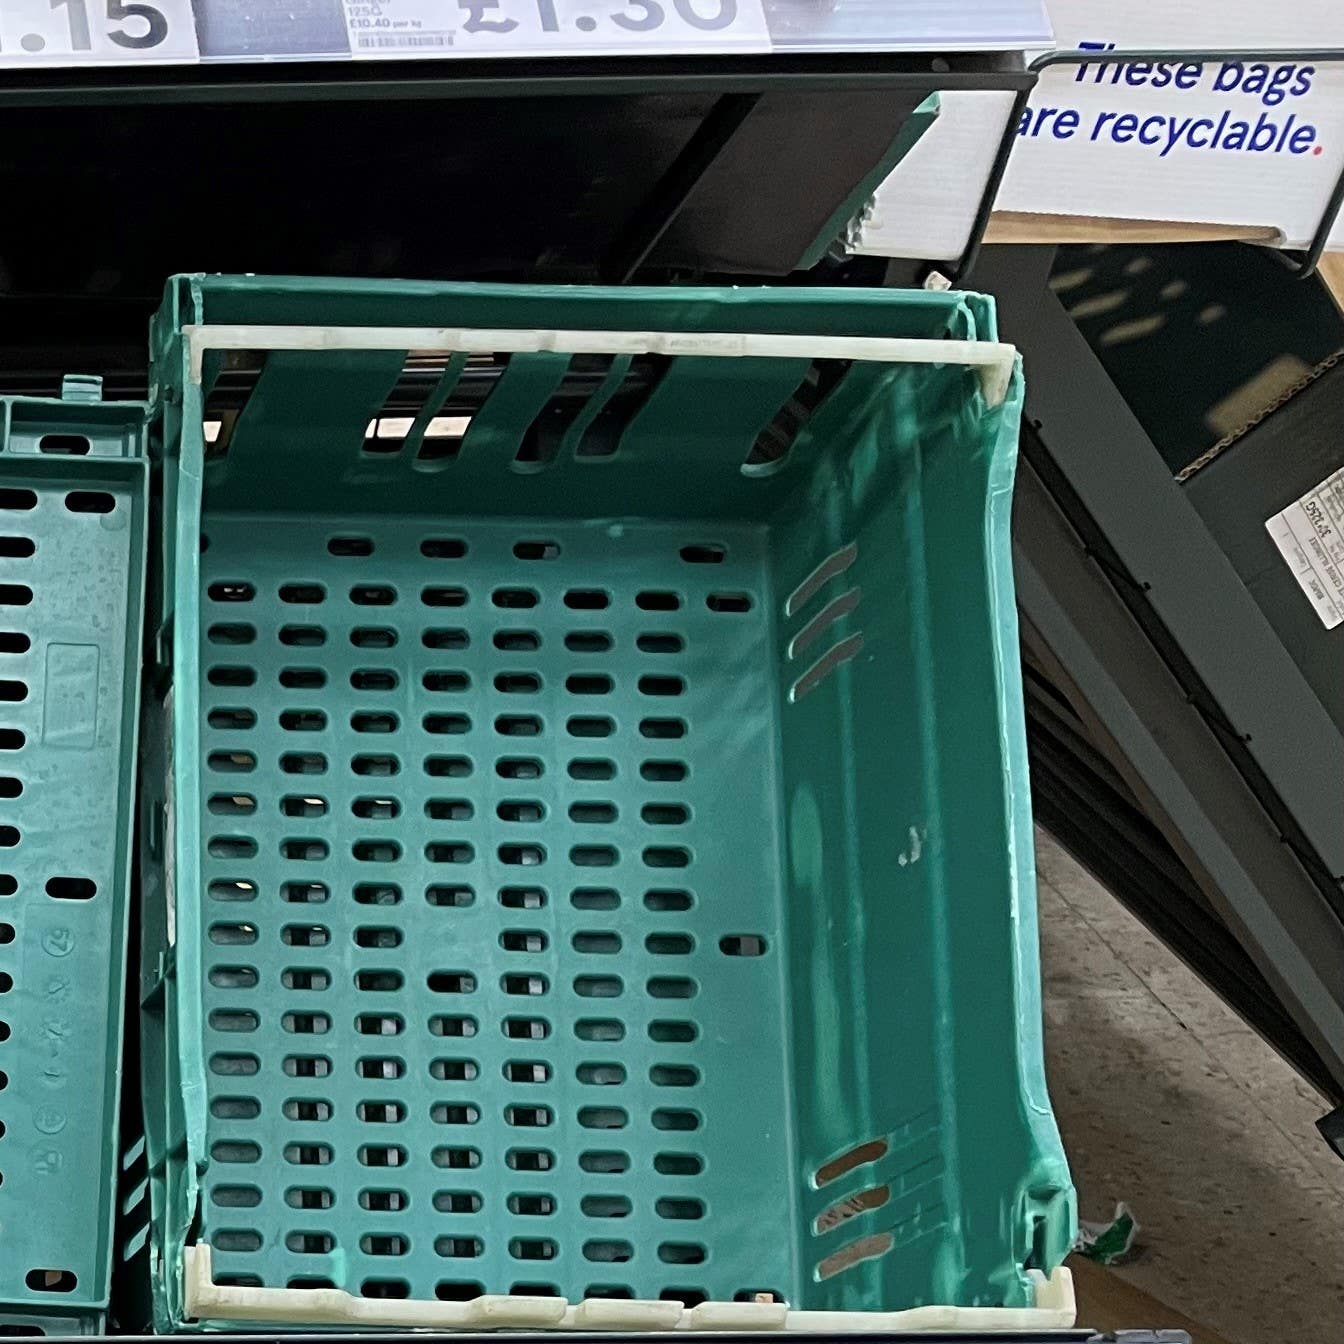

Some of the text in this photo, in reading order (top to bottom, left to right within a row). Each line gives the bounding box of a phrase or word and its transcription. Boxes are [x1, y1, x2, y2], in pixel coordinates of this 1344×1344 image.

[1075, 41, 1317, 106] These bags
[1013, 106, 1324, 157] are recyclable.
